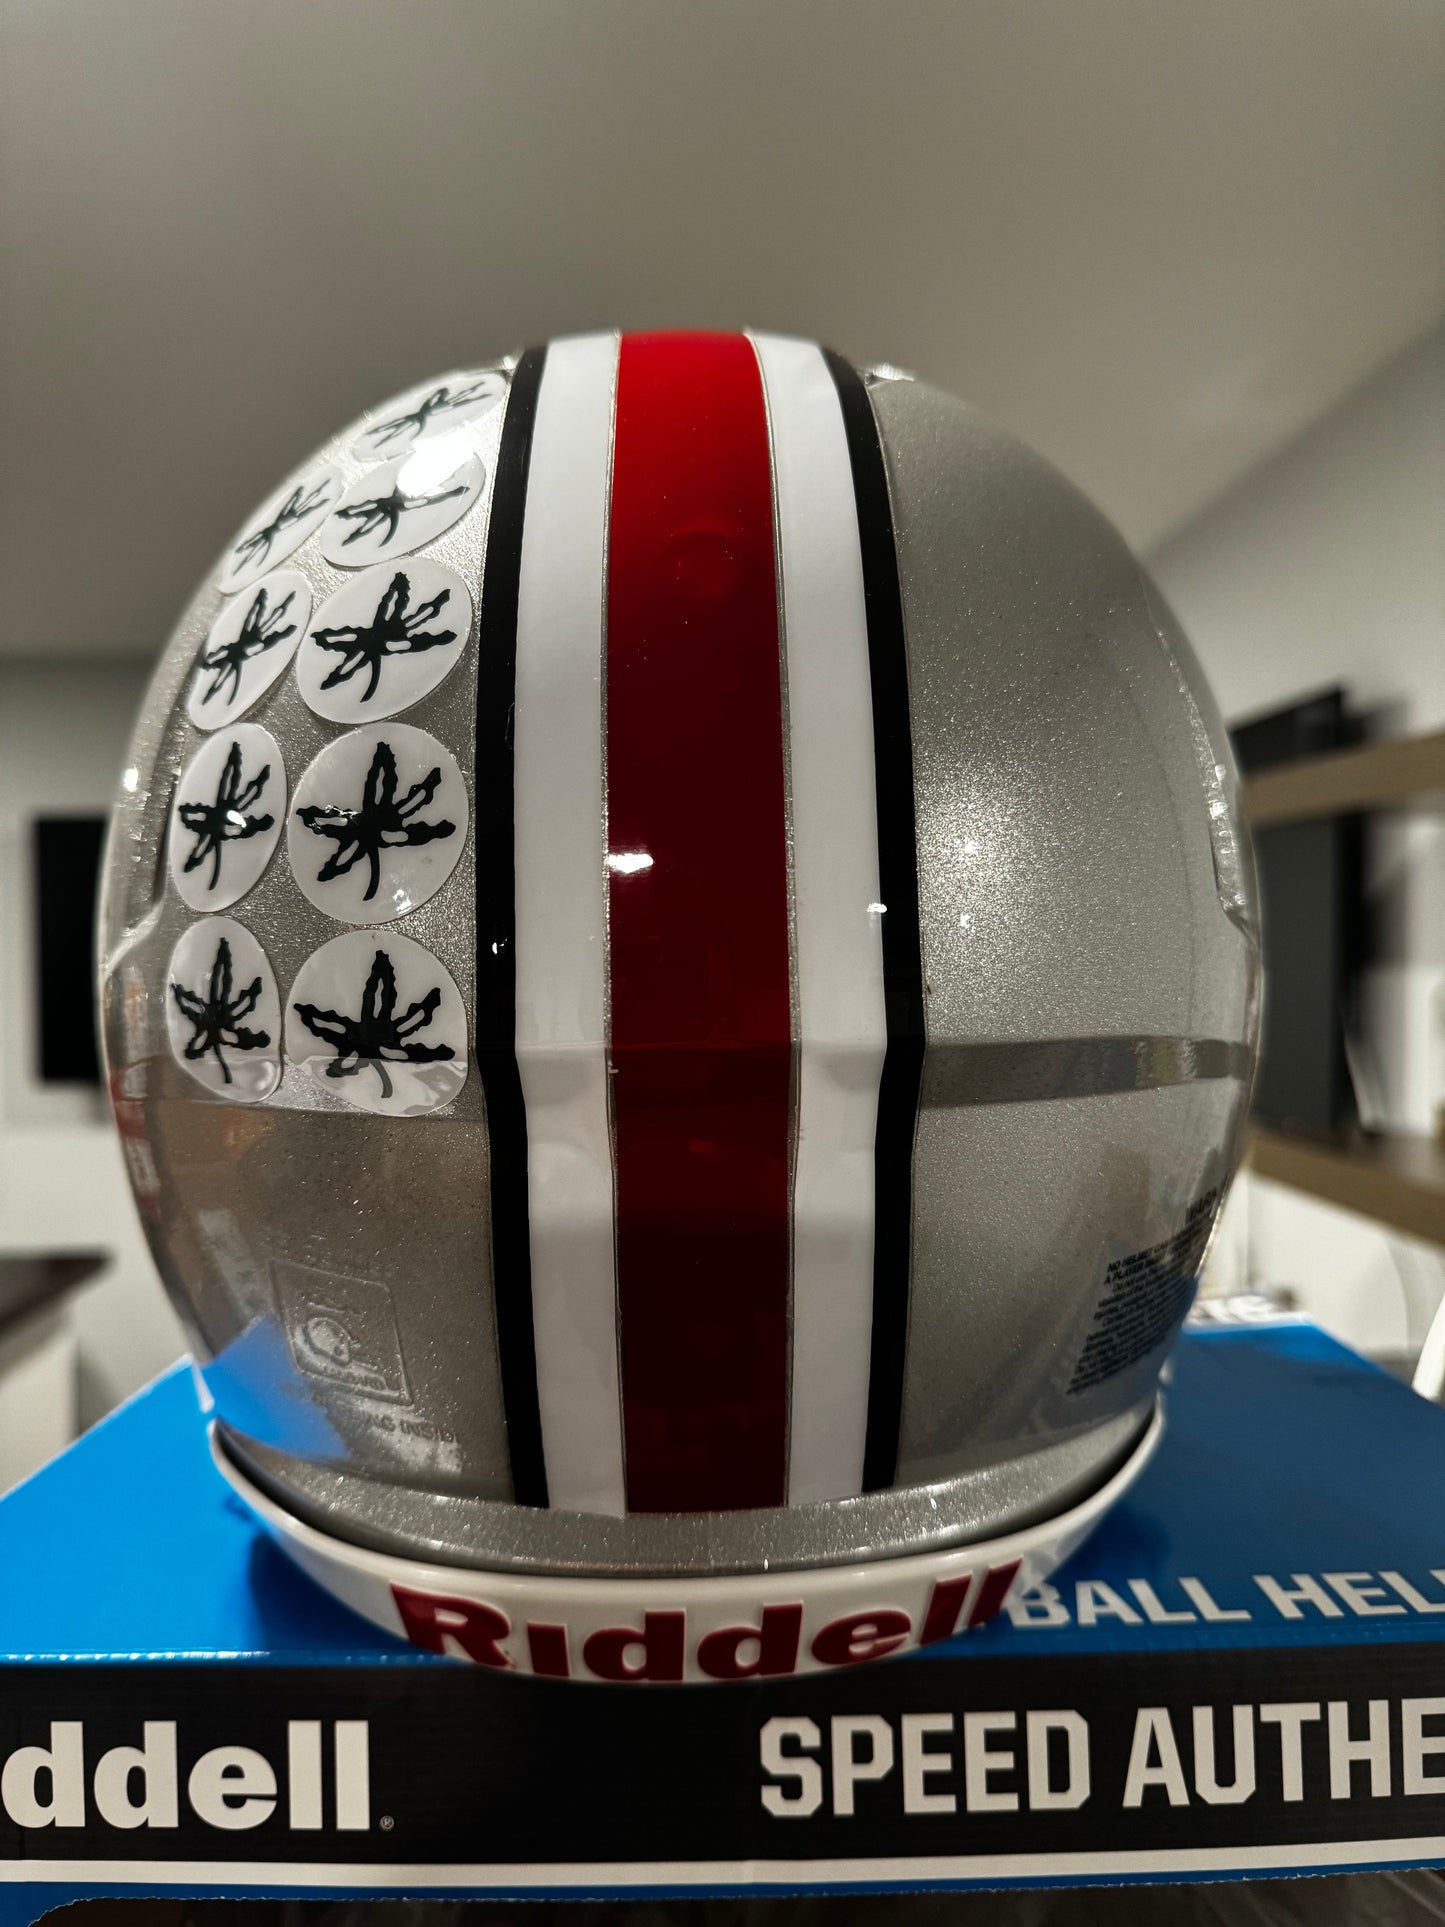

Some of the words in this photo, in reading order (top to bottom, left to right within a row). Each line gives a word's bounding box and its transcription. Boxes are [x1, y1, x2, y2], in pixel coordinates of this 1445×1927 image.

[389, 1557, 1023, 1683] Riddell
[1251, 1569, 1445, 1620] HEL
[760, 1709, 1090, 1818] SPEED
[1121, 1697, 1445, 1807] AUTHE
